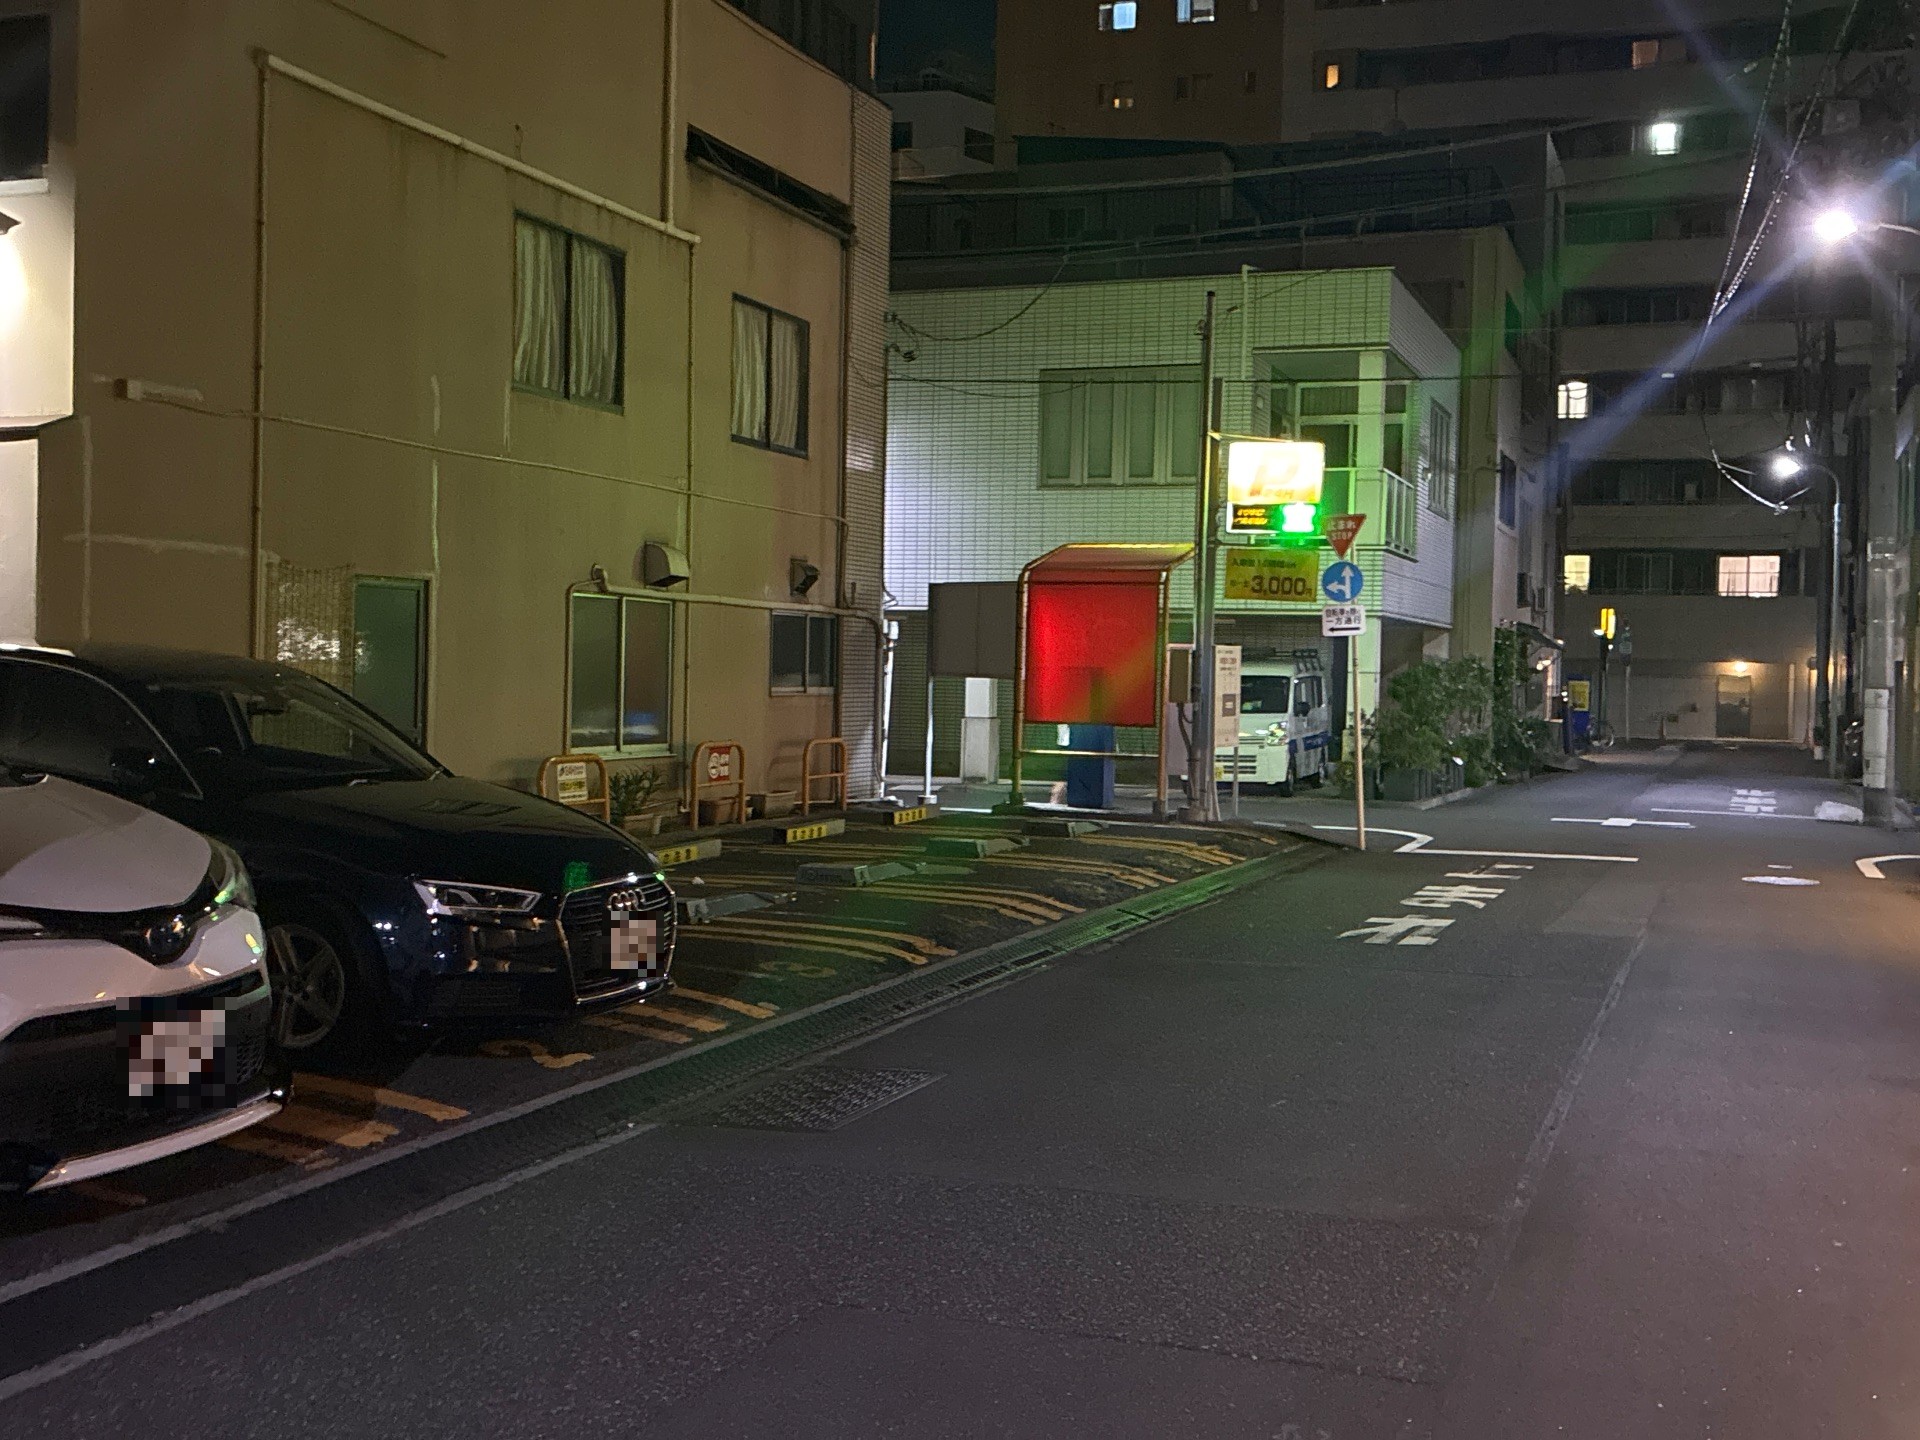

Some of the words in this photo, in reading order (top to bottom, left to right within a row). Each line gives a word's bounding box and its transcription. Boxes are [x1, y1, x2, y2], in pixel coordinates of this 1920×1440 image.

[1331, 531, 1353, 541] STOP
[1325, 615, 1362, 626] 一方通行
